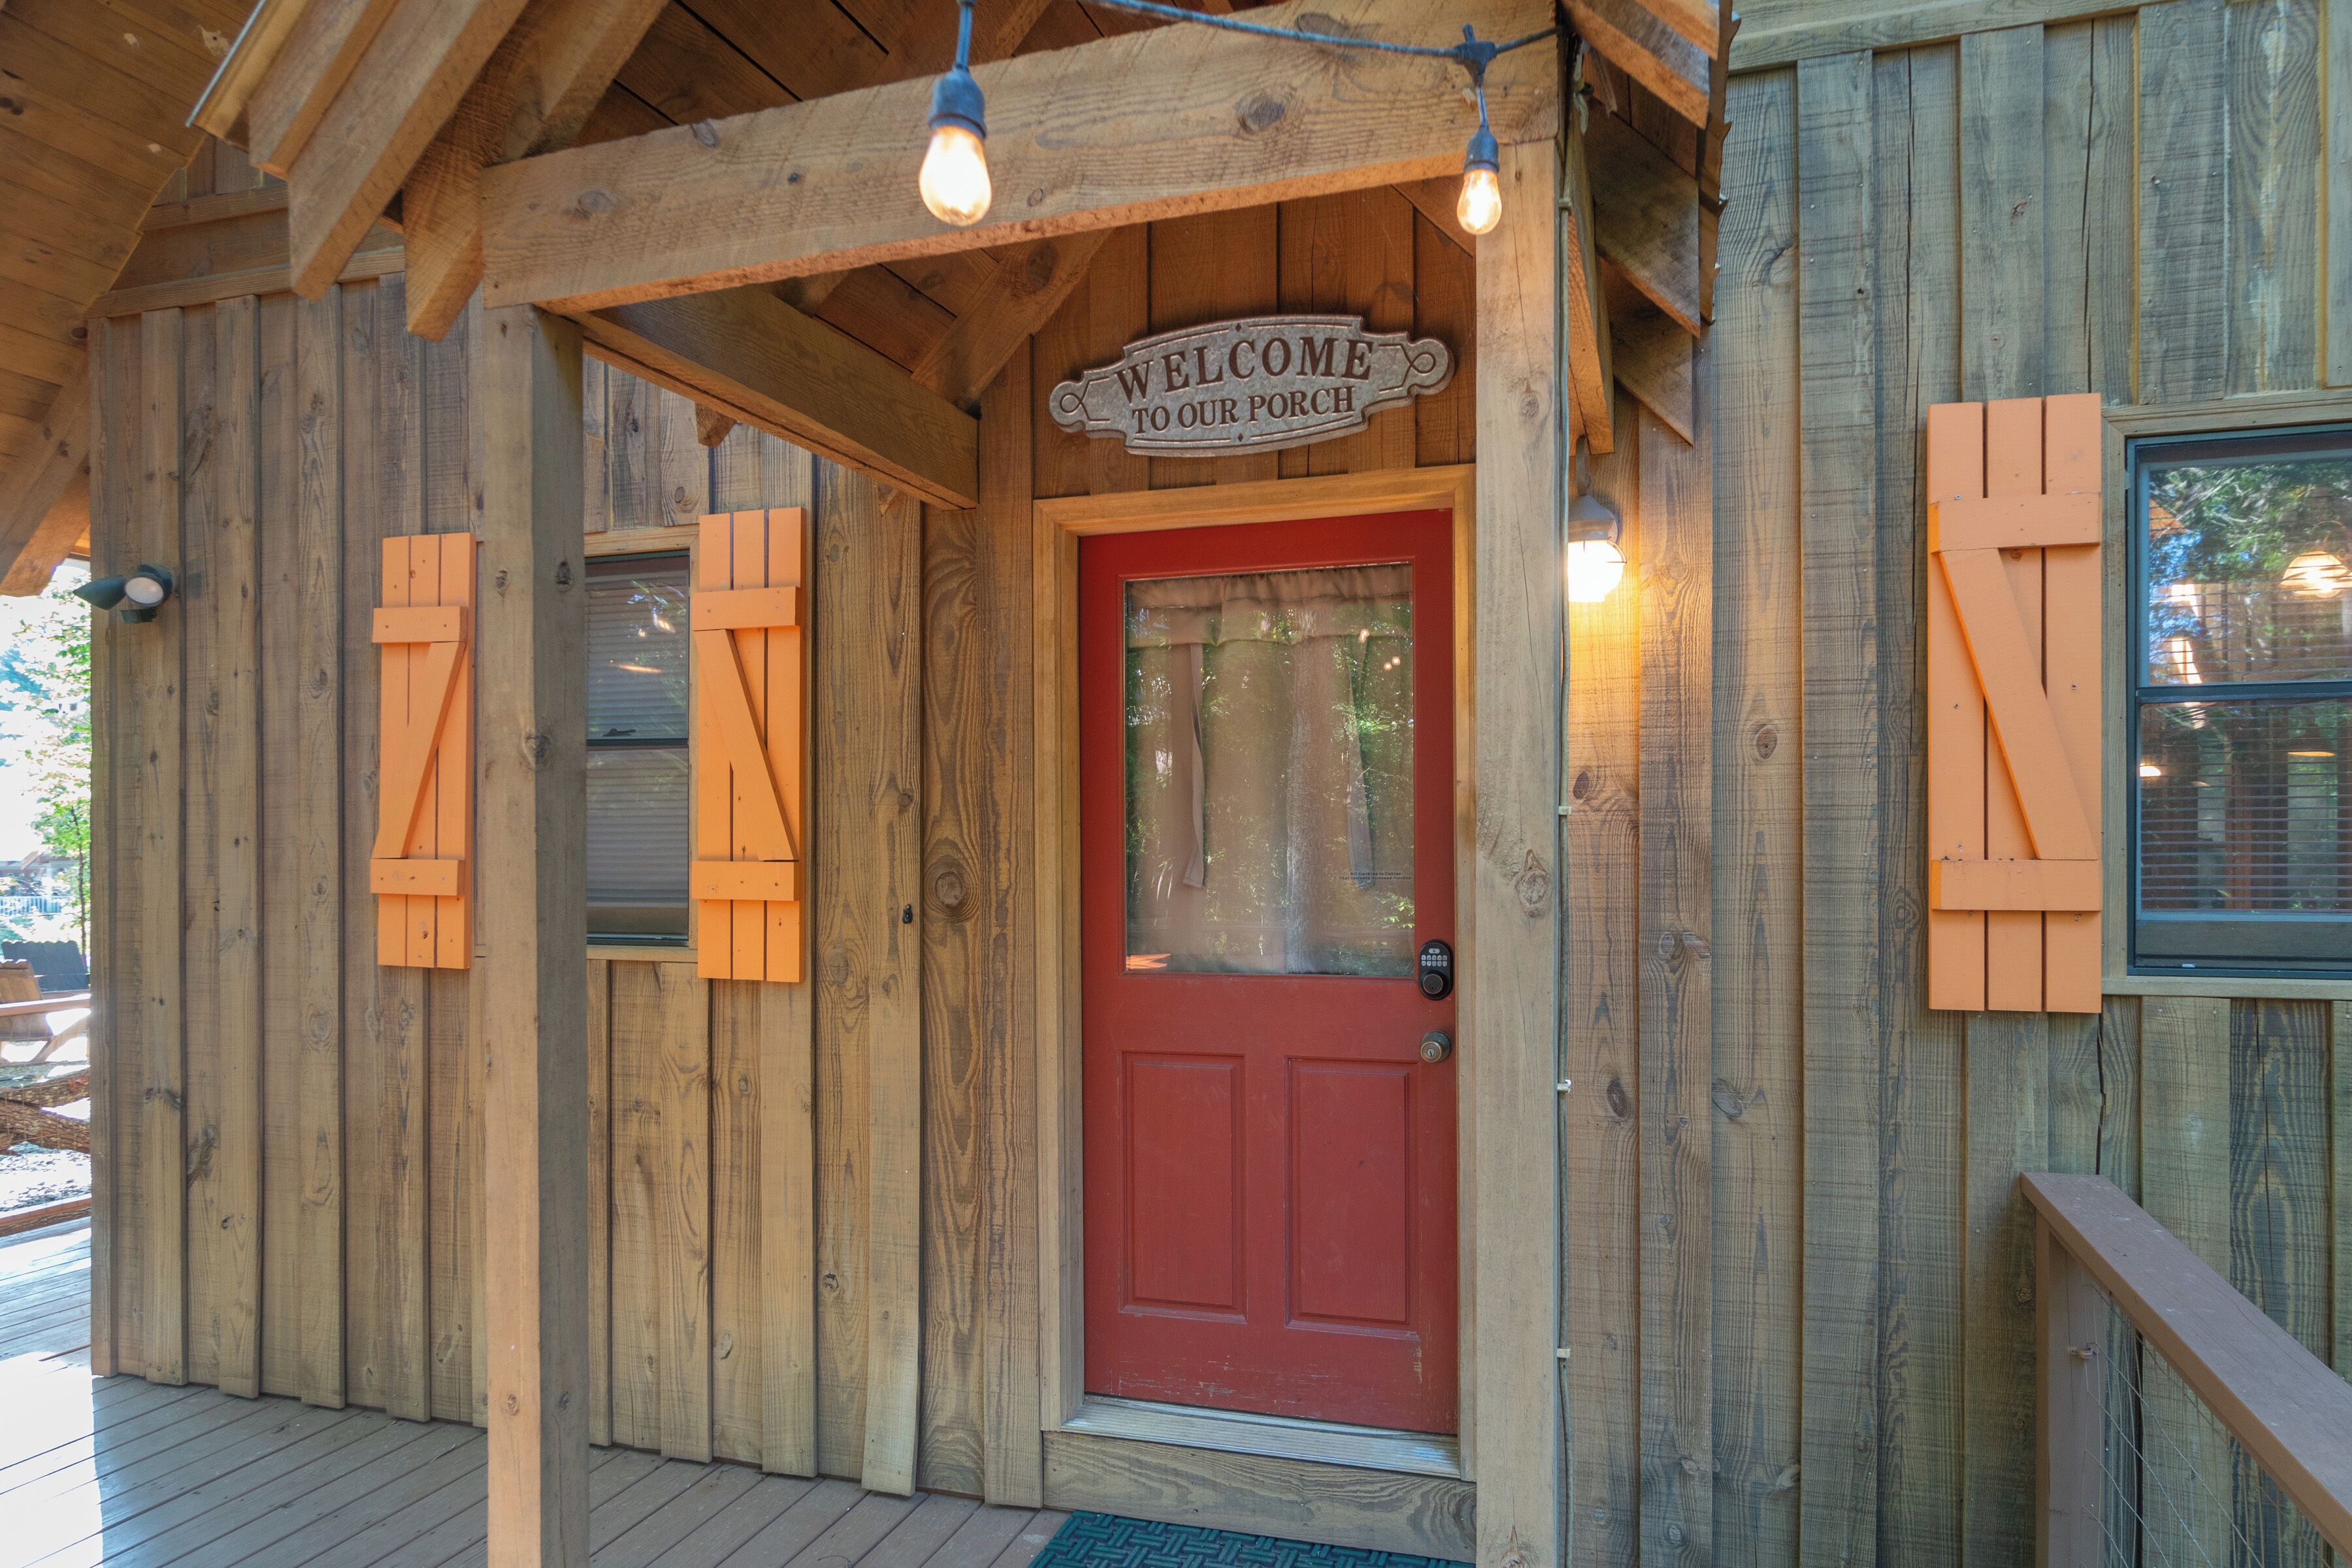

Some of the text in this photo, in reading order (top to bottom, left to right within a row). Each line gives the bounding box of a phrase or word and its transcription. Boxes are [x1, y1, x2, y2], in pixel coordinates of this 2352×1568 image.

[1114, 336, 1373, 404] WELCOME
[1132, 385, 1355, 434] TO OUR PORCH
